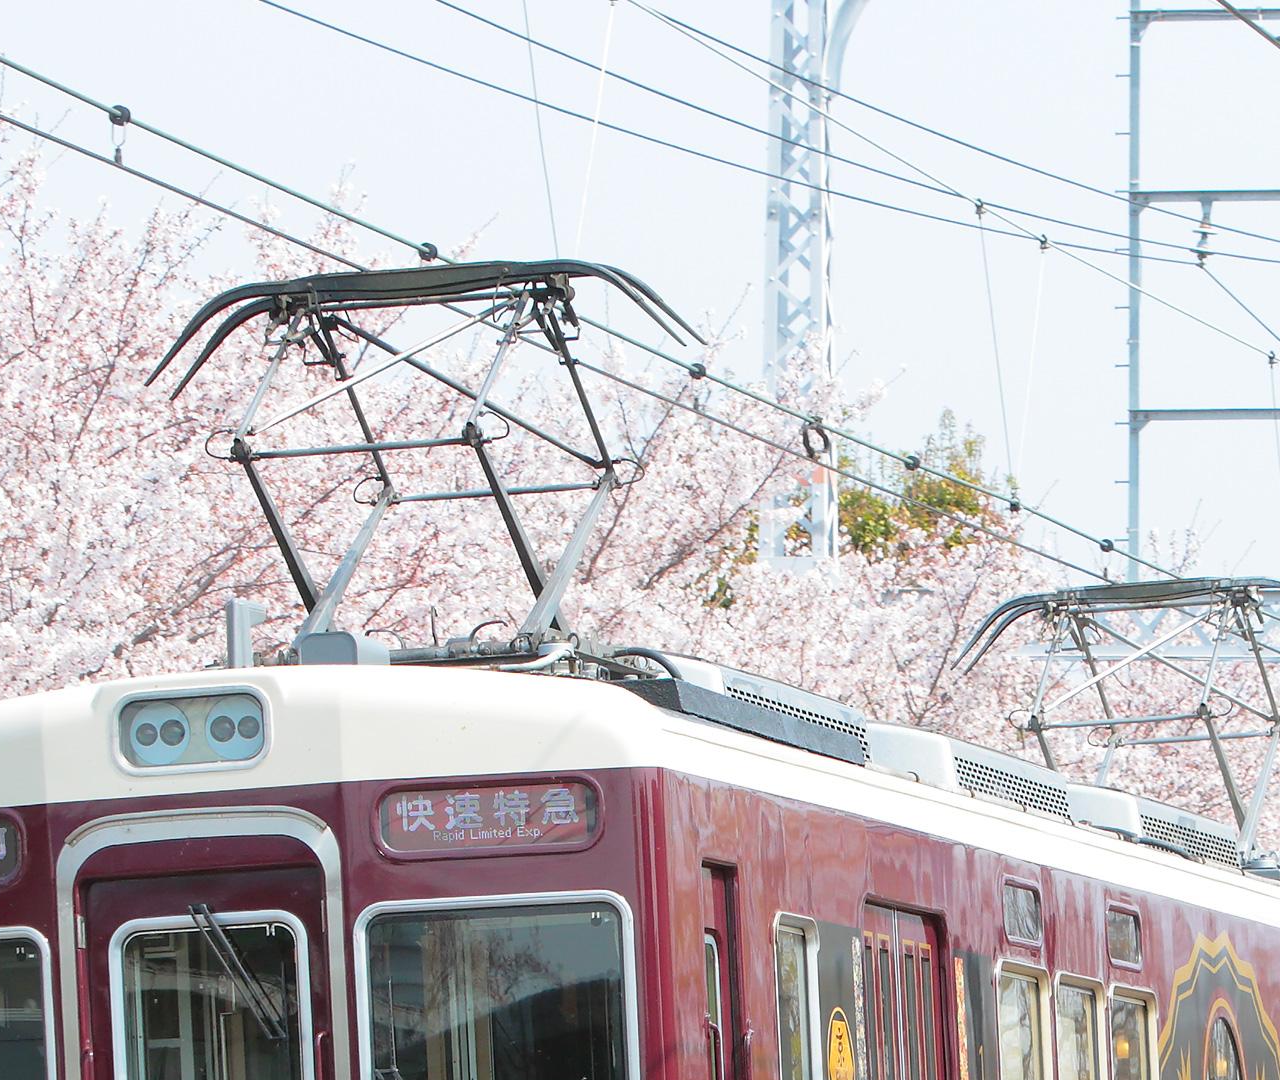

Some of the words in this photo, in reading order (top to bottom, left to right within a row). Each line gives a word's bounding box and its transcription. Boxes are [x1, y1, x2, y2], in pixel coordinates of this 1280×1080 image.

[395, 788, 580, 832] 快速特急
[432, 828, 465, 843] Rapid
[469, 827, 512, 841] Limited
[516, 826, 544, 841] Exp.
